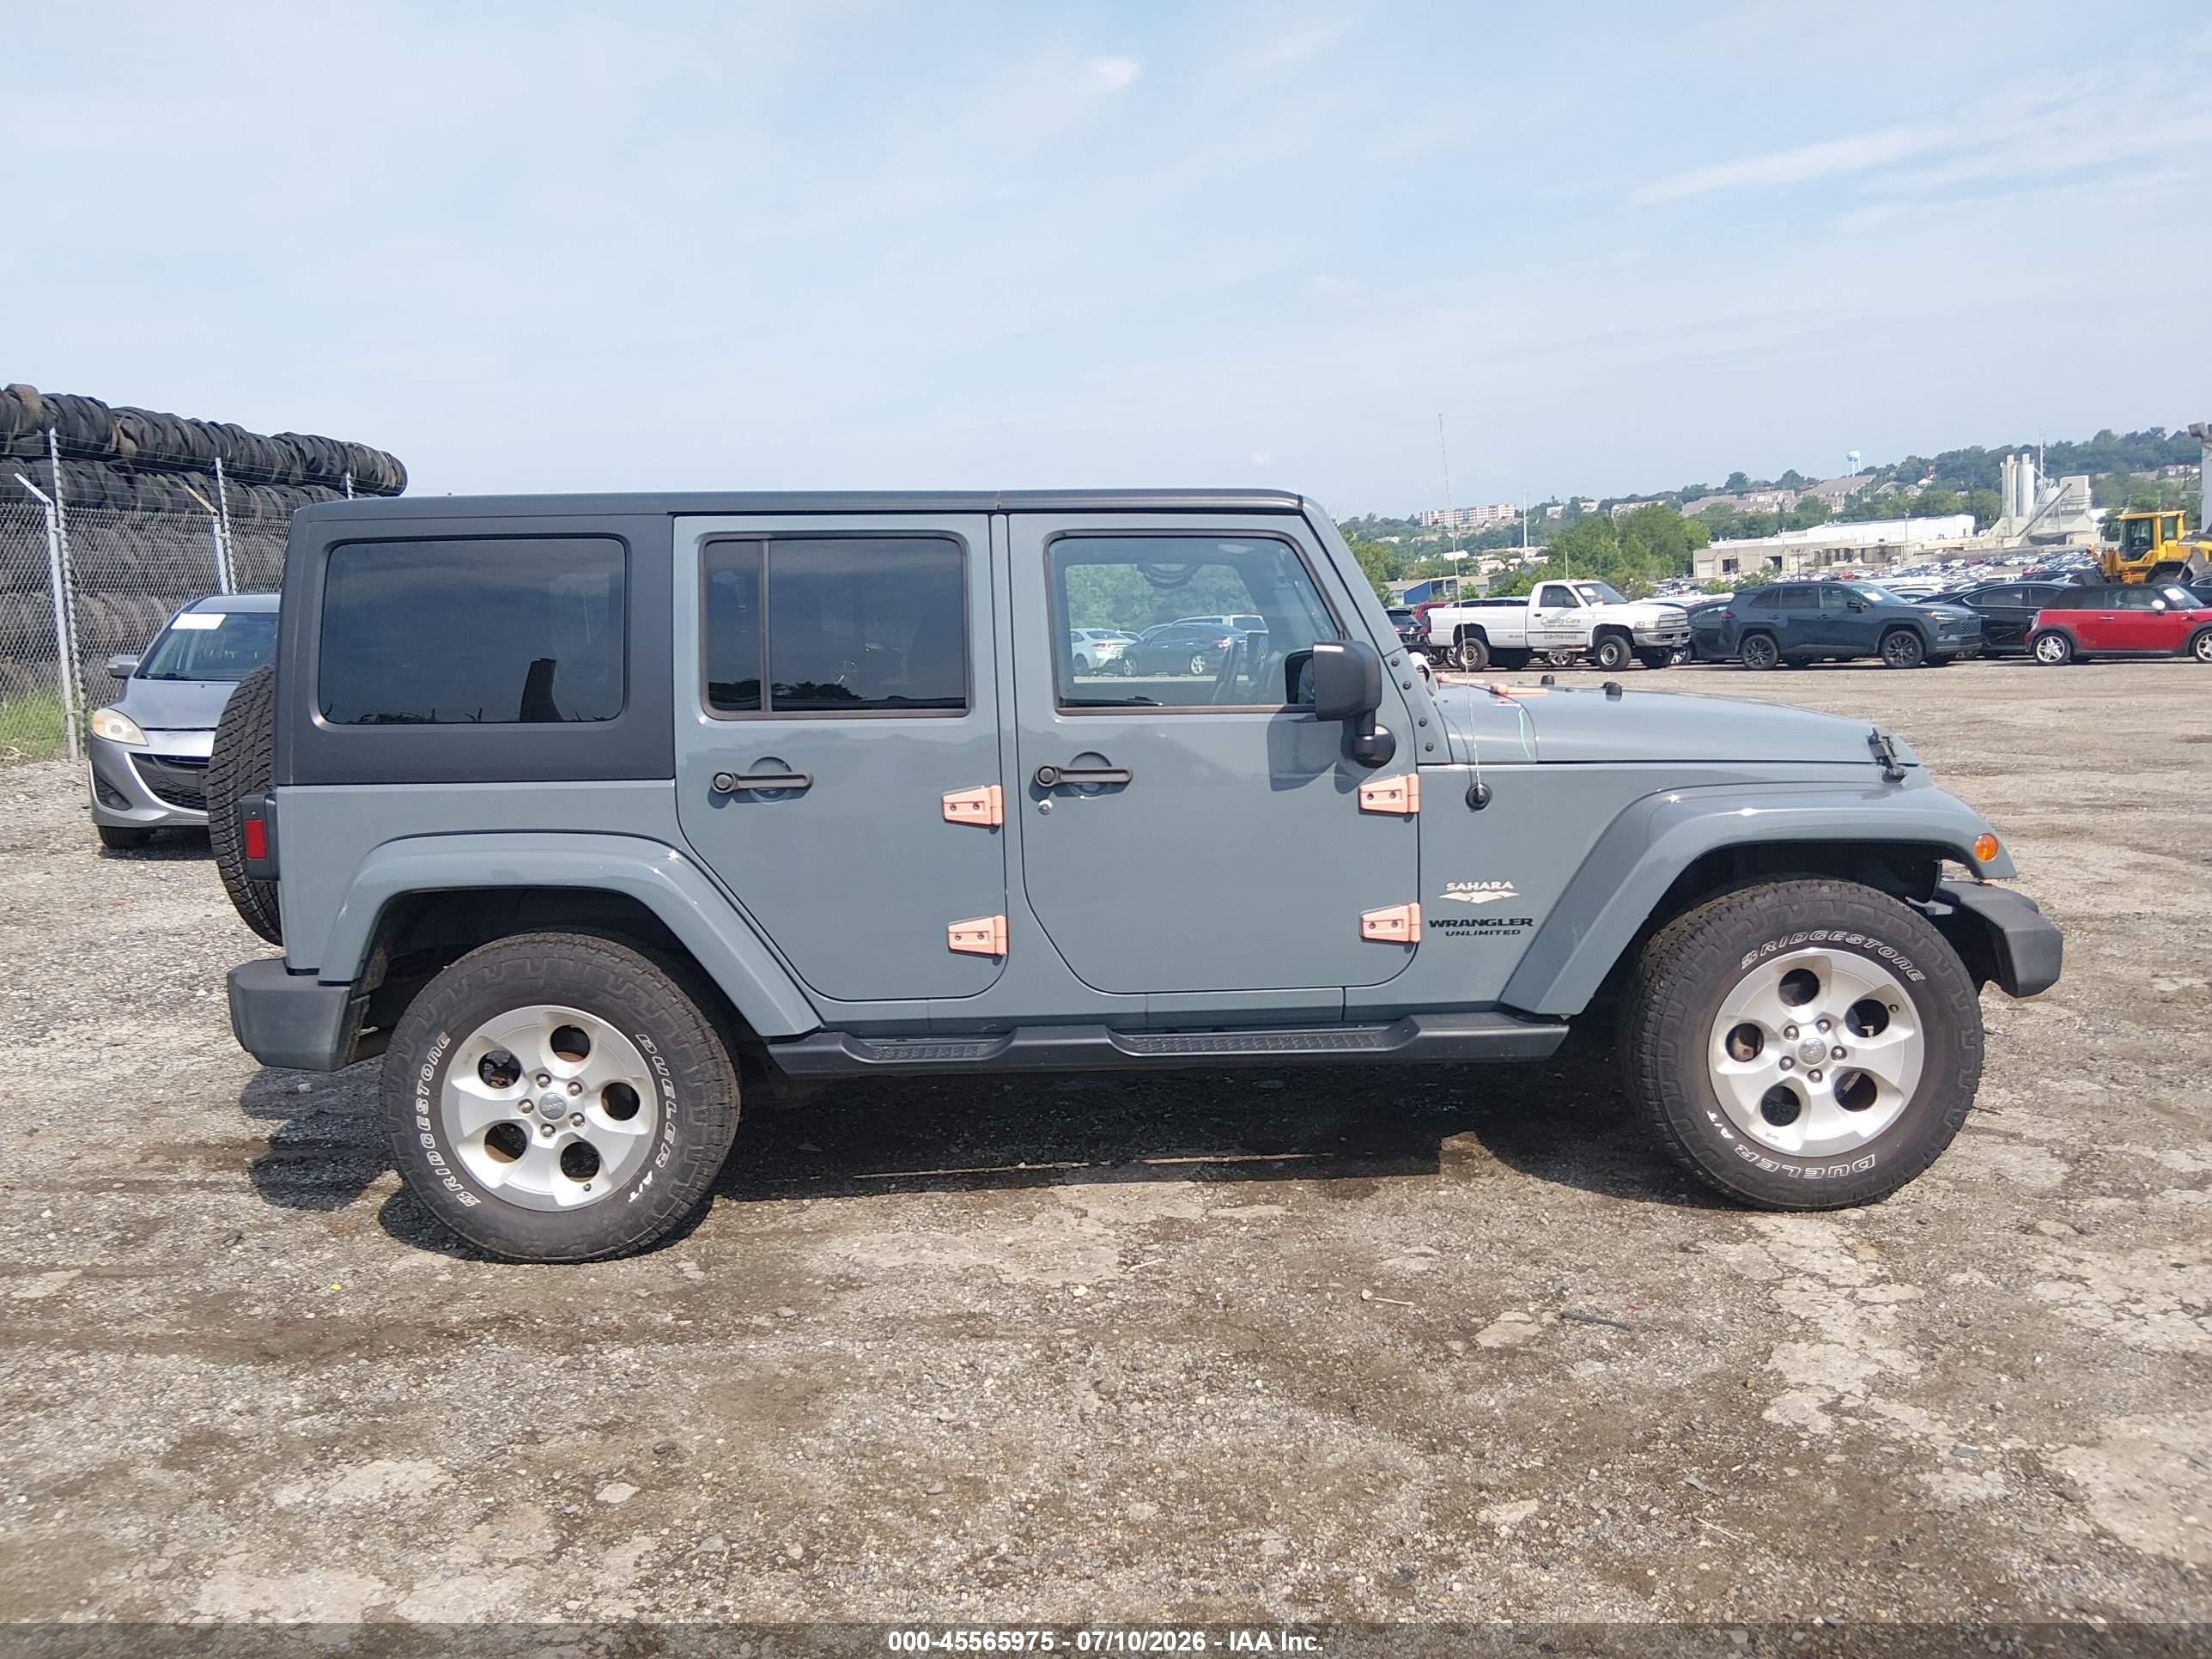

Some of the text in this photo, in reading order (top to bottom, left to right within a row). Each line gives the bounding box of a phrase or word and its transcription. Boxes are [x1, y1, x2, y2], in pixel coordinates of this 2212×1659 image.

[1446, 880, 1514, 890] SAHARA
[1429, 918, 1534, 927] WRANGLER
[1741, 930, 1925, 981] BRIDGESTONE
[416, 1031, 482, 1206] BRIDGESTONE
[635, 1034, 677, 1168] DUELER
[1735, 1144, 1875, 1180] DUELER
